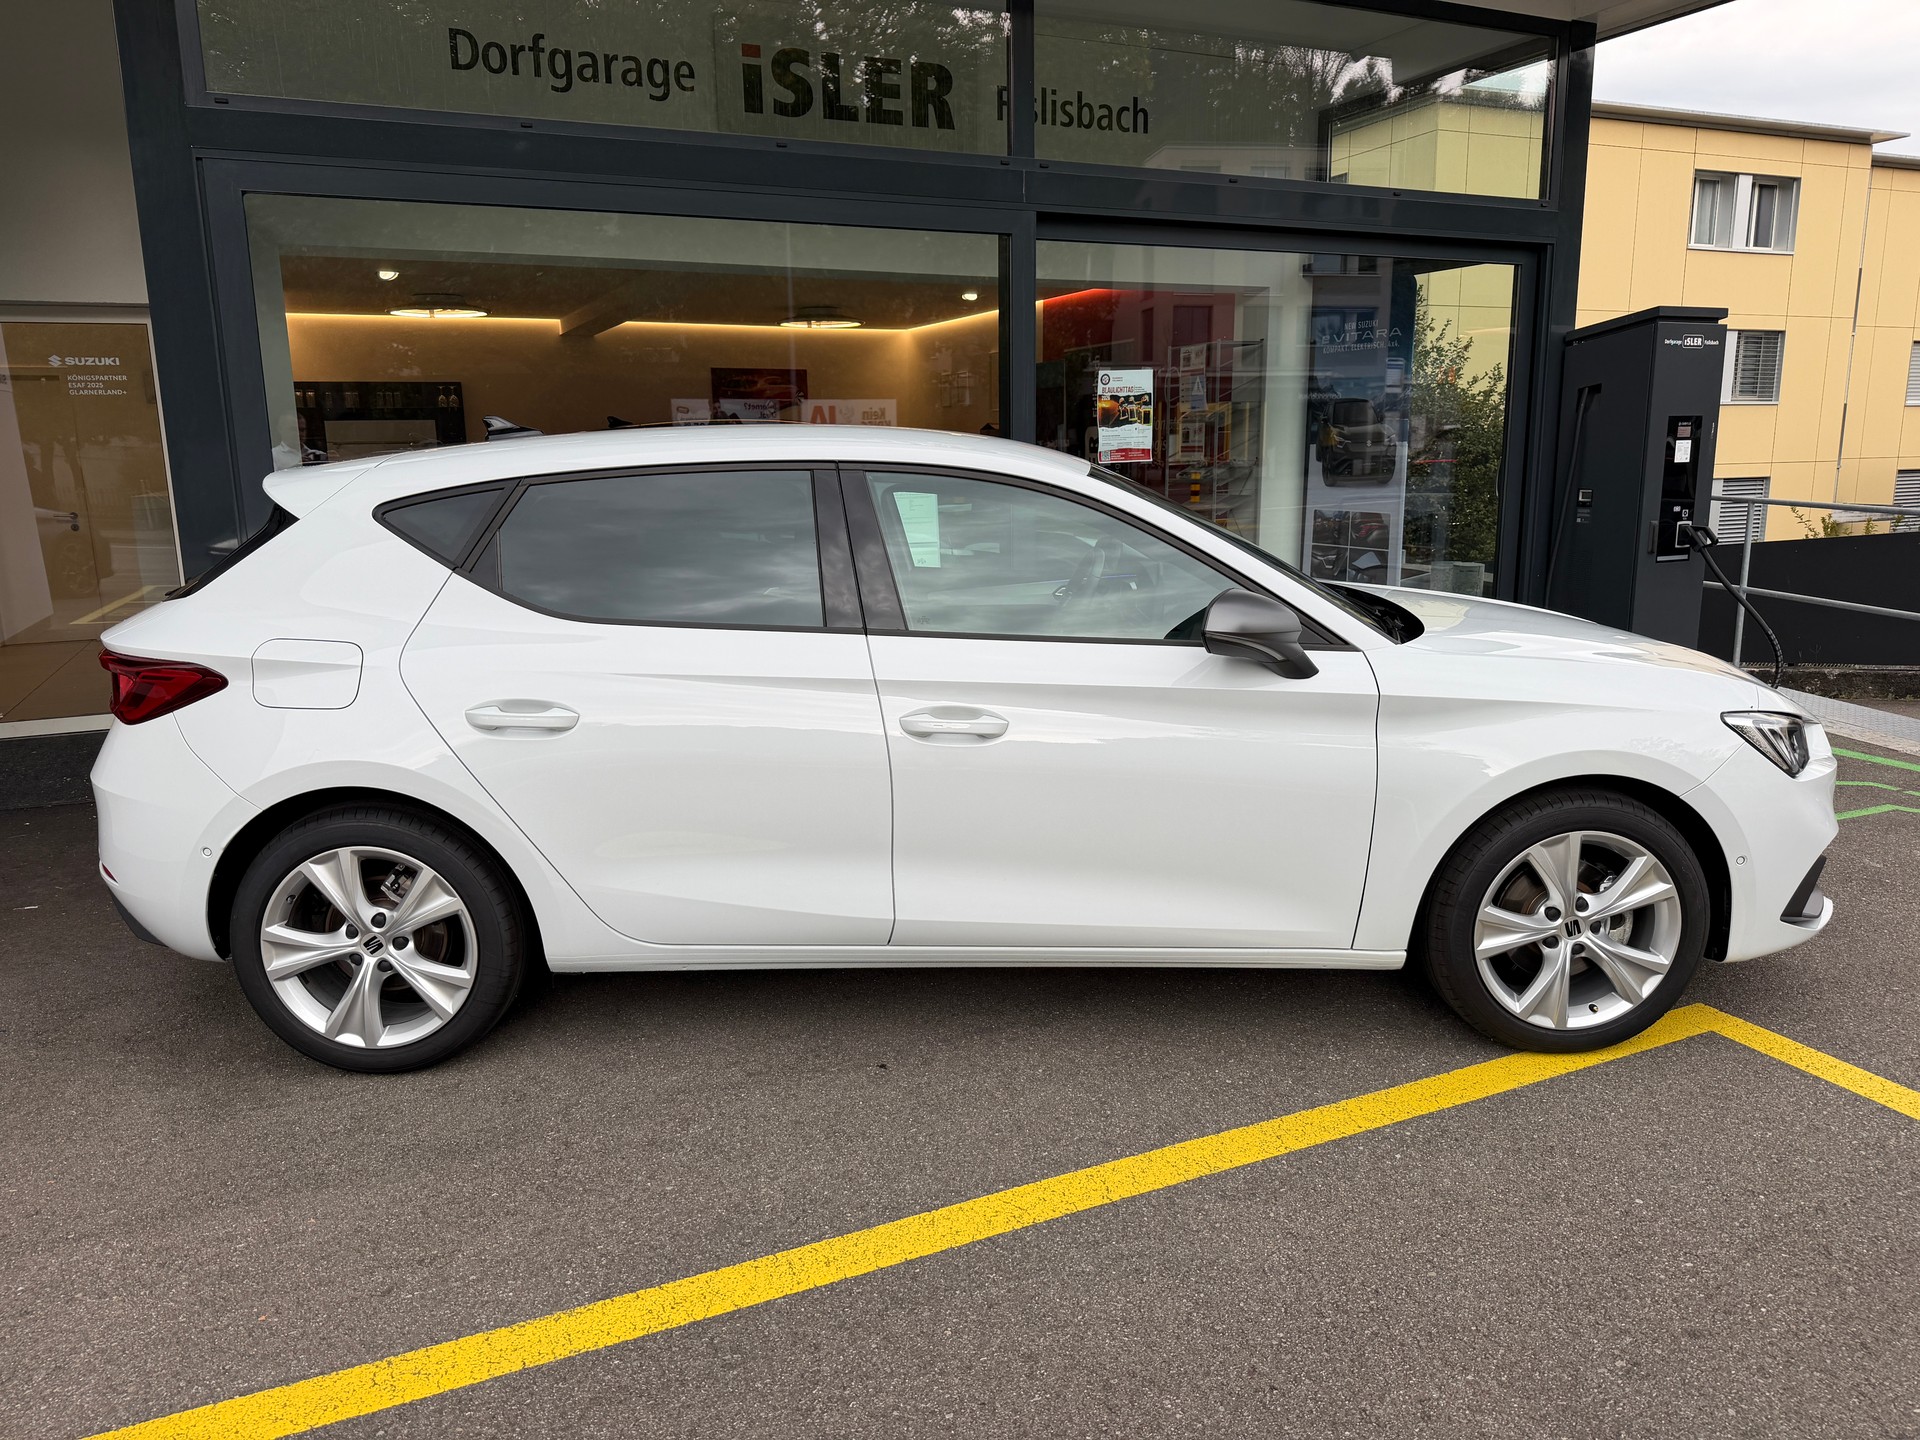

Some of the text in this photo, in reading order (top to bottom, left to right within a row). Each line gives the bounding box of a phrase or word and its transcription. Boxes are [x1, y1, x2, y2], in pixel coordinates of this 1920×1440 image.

[448, 27, 1149, 134] Dorfgarage iSLER Flisbach
[1358, 319, 1379, 329] SUZUKI
[1333, 327, 1402, 342] VITARA
[64, 356, 120, 366] SUZUKI
[1101, 386, 1134, 394] BLAULICHTTAG
